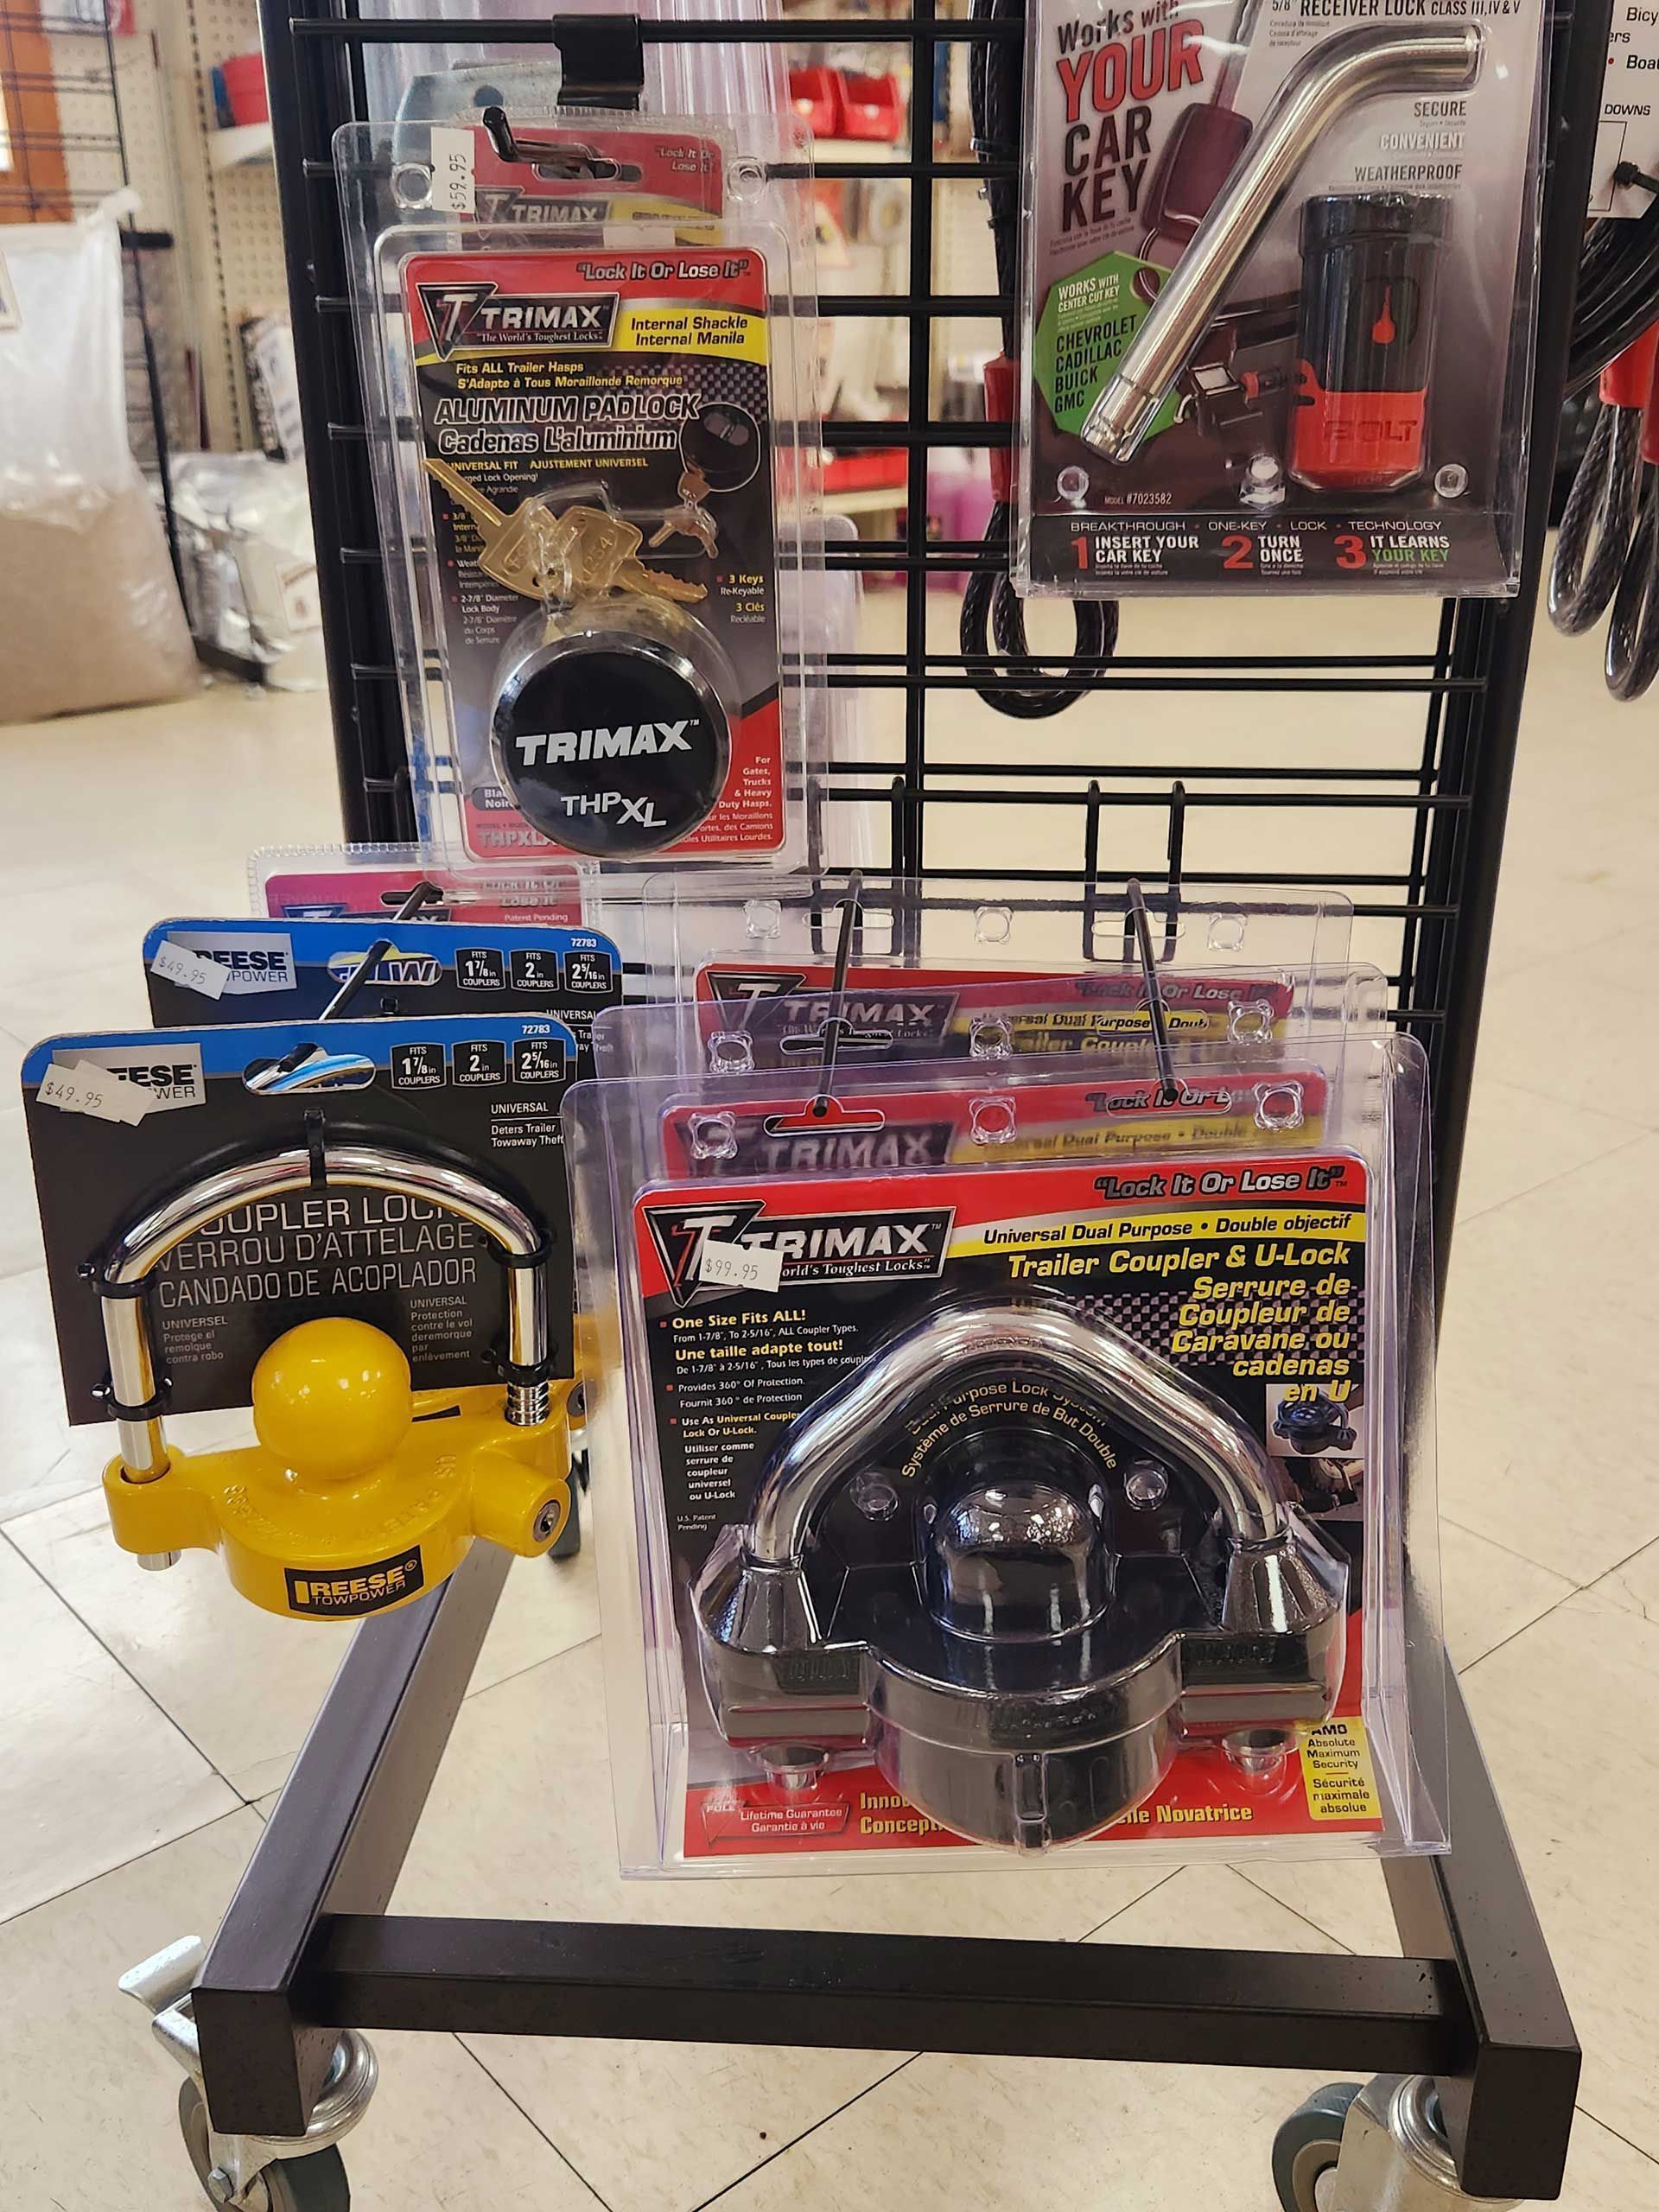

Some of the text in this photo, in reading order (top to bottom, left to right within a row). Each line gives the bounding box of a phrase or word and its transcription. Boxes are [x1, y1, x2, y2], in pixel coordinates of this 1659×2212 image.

[1300, 0, 1467, 16] RECEIVER LOCK CLASS
[1058, 10, 1134, 54] Works
[1057, 19, 1204, 123] YOUR
[1414, 101, 1466, 117] SECURE
[1605, 104, 1650, 115] DOWNS
[1065, 105, 1152, 175] CAR
[1380, 131, 1465, 151] CONVENIENT
[1355, 164, 1462, 181] WEATHERPROOF
[450, 154, 467, 210] $59.95
[1062, 159, 1147, 233] KEY
[511, 204, 598, 222] TRIMAX
[631, 264, 647, 280] It
[650, 263, 674, 280] Or
[677, 264, 719, 280] Lose
[1058, 275, 1119, 301] WORKS WITH
[480, 305, 601, 329] TRIMAX
[631, 316, 747, 331] Internal Shackle
[635, 333, 745, 346] Internal Manila
[1056, 315, 1136, 353] CHEVROLET
[1056, 339, 1122, 373] CADILLAC
[456, 362, 583, 374] Fits ALL Trailer Hasps
[457, 378, 510, 391] S'Adapte
[524, 378, 550, 388] Tous
[626, 375, 683, 388] Remorque
[1055, 366, 1098, 394] BUICK
[435, 393, 702, 425] ALUMINUM PADLOCK
[1055, 391, 1084, 413] GMC
[439, 425, 677, 454] Cadenas L'aluminium
[530, 458, 649, 469] AJUSTEMENT UNIVERSEL
[1127, 493, 1172, 506] #7023582
[1071, 520, 1441, 531] BREAKTHROUGH ONE-KEY LOCK TECHNOLOGY
[1095, 536, 1199, 550] INSERT YOUR
[1258, 535, 1300, 549] TURN
[1370, 535, 1450, 549] IT LEARNS
[1071, 536, 1088, 569] 1
[1096, 550, 1162, 563] CAR KEY
[1223, 535, 1253, 569] 2
[1260, 549, 1304, 563] ONCE
[1334, 535, 1366, 569] 3
[1371, 549, 1450, 563] YOUR KEY
[515, 720, 693, 766] TRIMAX
[561, 791, 667, 828] THPXL
[533, 913, 568, 922] Pending
[570, 938, 597, 947] 72783
[159, 957, 207, 985] $49.95
[522, 1025, 550, 1034] 72783
[398, 1076, 440, 1085] COUPLERS
[459, 1072, 501, 1082] COUPLERS
[520, 1070, 559, 1079] COUPLERS
[45, 1082, 104, 1108] $49.95
[491, 1103, 550, 1114] UNIVERSAL
[491, 1124, 556, 1135] Deters Trailer
[492, 1135, 564, 1148] Towaway Theft
[1171, 1175, 1193, 1197] It
[1199, 1172, 1234, 1194] Or
[1241, 1170, 1300, 1192] Lose
[983, 1214, 1351, 1245] Universal Dual Purpose Double objectif
[296, 1223, 474, 1262] D'ATTELAGE
[741, 1224, 930, 1260] TRIMAX
[1008, 1242, 1351, 1279] Trailer Coupler & U-Lock
[705, 1258, 760, 1281] $99.95
[159, 1257, 476, 1309] CANDADO DE ACOPLADOR
[1192, 1273, 1351, 1300] Serrure de
[410, 1296, 467, 1308] UNIVERSAL
[162, 1315, 228, 1331] UNIVERSEL
[672, 1309, 806, 1329] One Size Fits ALL!
[1179, 1300, 1351, 1329] Coupleur de
[676, 1339, 843, 1361] Une taille adapte tout!
[1172, 1330, 1350, 1354] Caravane ou
[1232, 1355, 1350, 1376] cadenas
[1012, 1381, 1050, 1396] Lock
[1284, 1379, 1351, 1403] en U
[680, 1393, 803, 1409] Fournit Protection
[717, 1414, 761, 1424] Universal
[683, 1429, 705, 1439] Lock
[722, 1426, 757, 1435] U-Lock.
[901, 1420, 950, 1478] Système
[950, 1410, 968, 1427] de
[968, 1401, 1028, 1418] Serrure
[1033, 1402, 1050, 1416] de
[1052, 1408, 1080, 1428] But
[1078, 1422, 1117, 1469] Double
[684, 1444, 718, 1453] Utiliser
[687, 1468, 728, 1478] coupleur
[689, 1479, 731, 1489] universel
[309, 1566, 405, 1596] REESE
[313, 1580, 406, 1605] TOWPOWER
[1307, 1738, 1356, 1747] Absolute
[1306, 1748, 1360, 1758] Maximum
[1313, 1759, 1358, 1770] Security
[1313, 1777, 1364, 1789] Sécurité
[740, 1808, 842, 1821] Lifetime Guarantee
[1156, 1803, 1253, 1823] Novatrice
[1320, 1802, 1367, 1813] absolue
